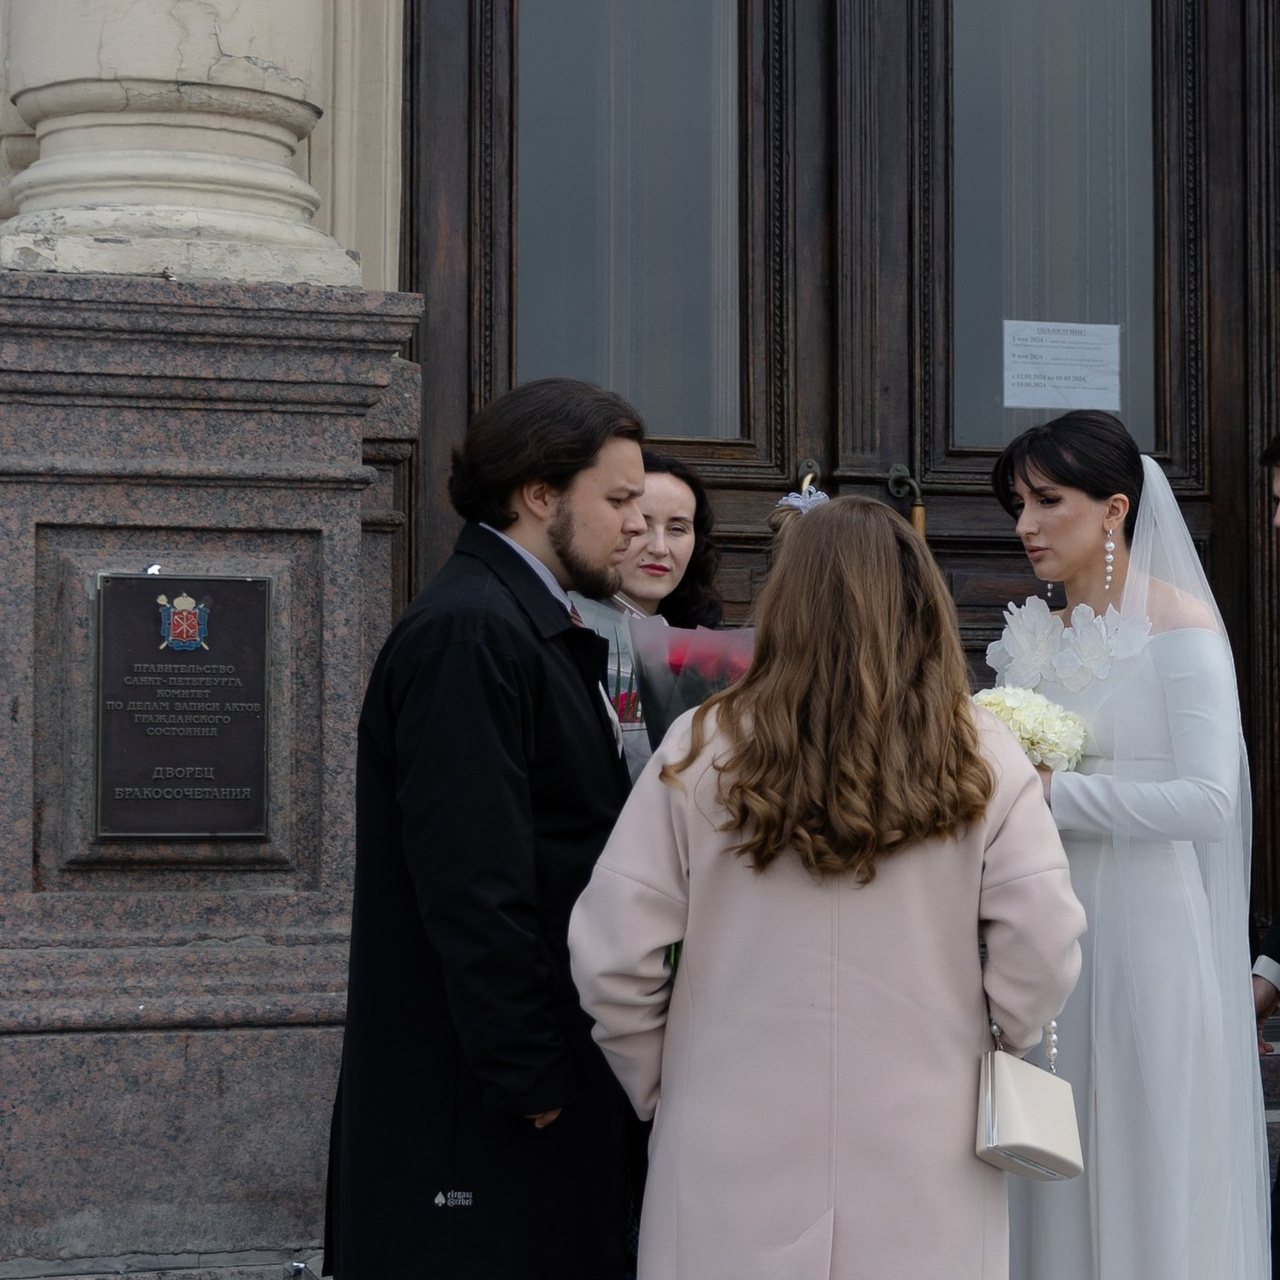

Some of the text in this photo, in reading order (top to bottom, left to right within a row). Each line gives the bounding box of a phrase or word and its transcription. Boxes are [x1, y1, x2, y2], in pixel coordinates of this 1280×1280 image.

[133, 663, 236, 674] ПРАВИТЕЛЬСТВО
[124, 676, 243, 687] САНКТ-ПЕТЕРБУРГА
[156, 689, 211, 699] КОМИТЕТ
[106, 701, 262, 713] ПО ДЕЛАМ ЗАПИСИ АКТОВ
[134, 714, 231, 725] ГРАЖДАНСКОГО
[146, 727, 218, 737] СОСТОЯНИЯ
[151, 766, 215, 780] ДВОРЕЦ
[113, 787, 252, 800] БРАКОСОЧЕТАНИЯ
